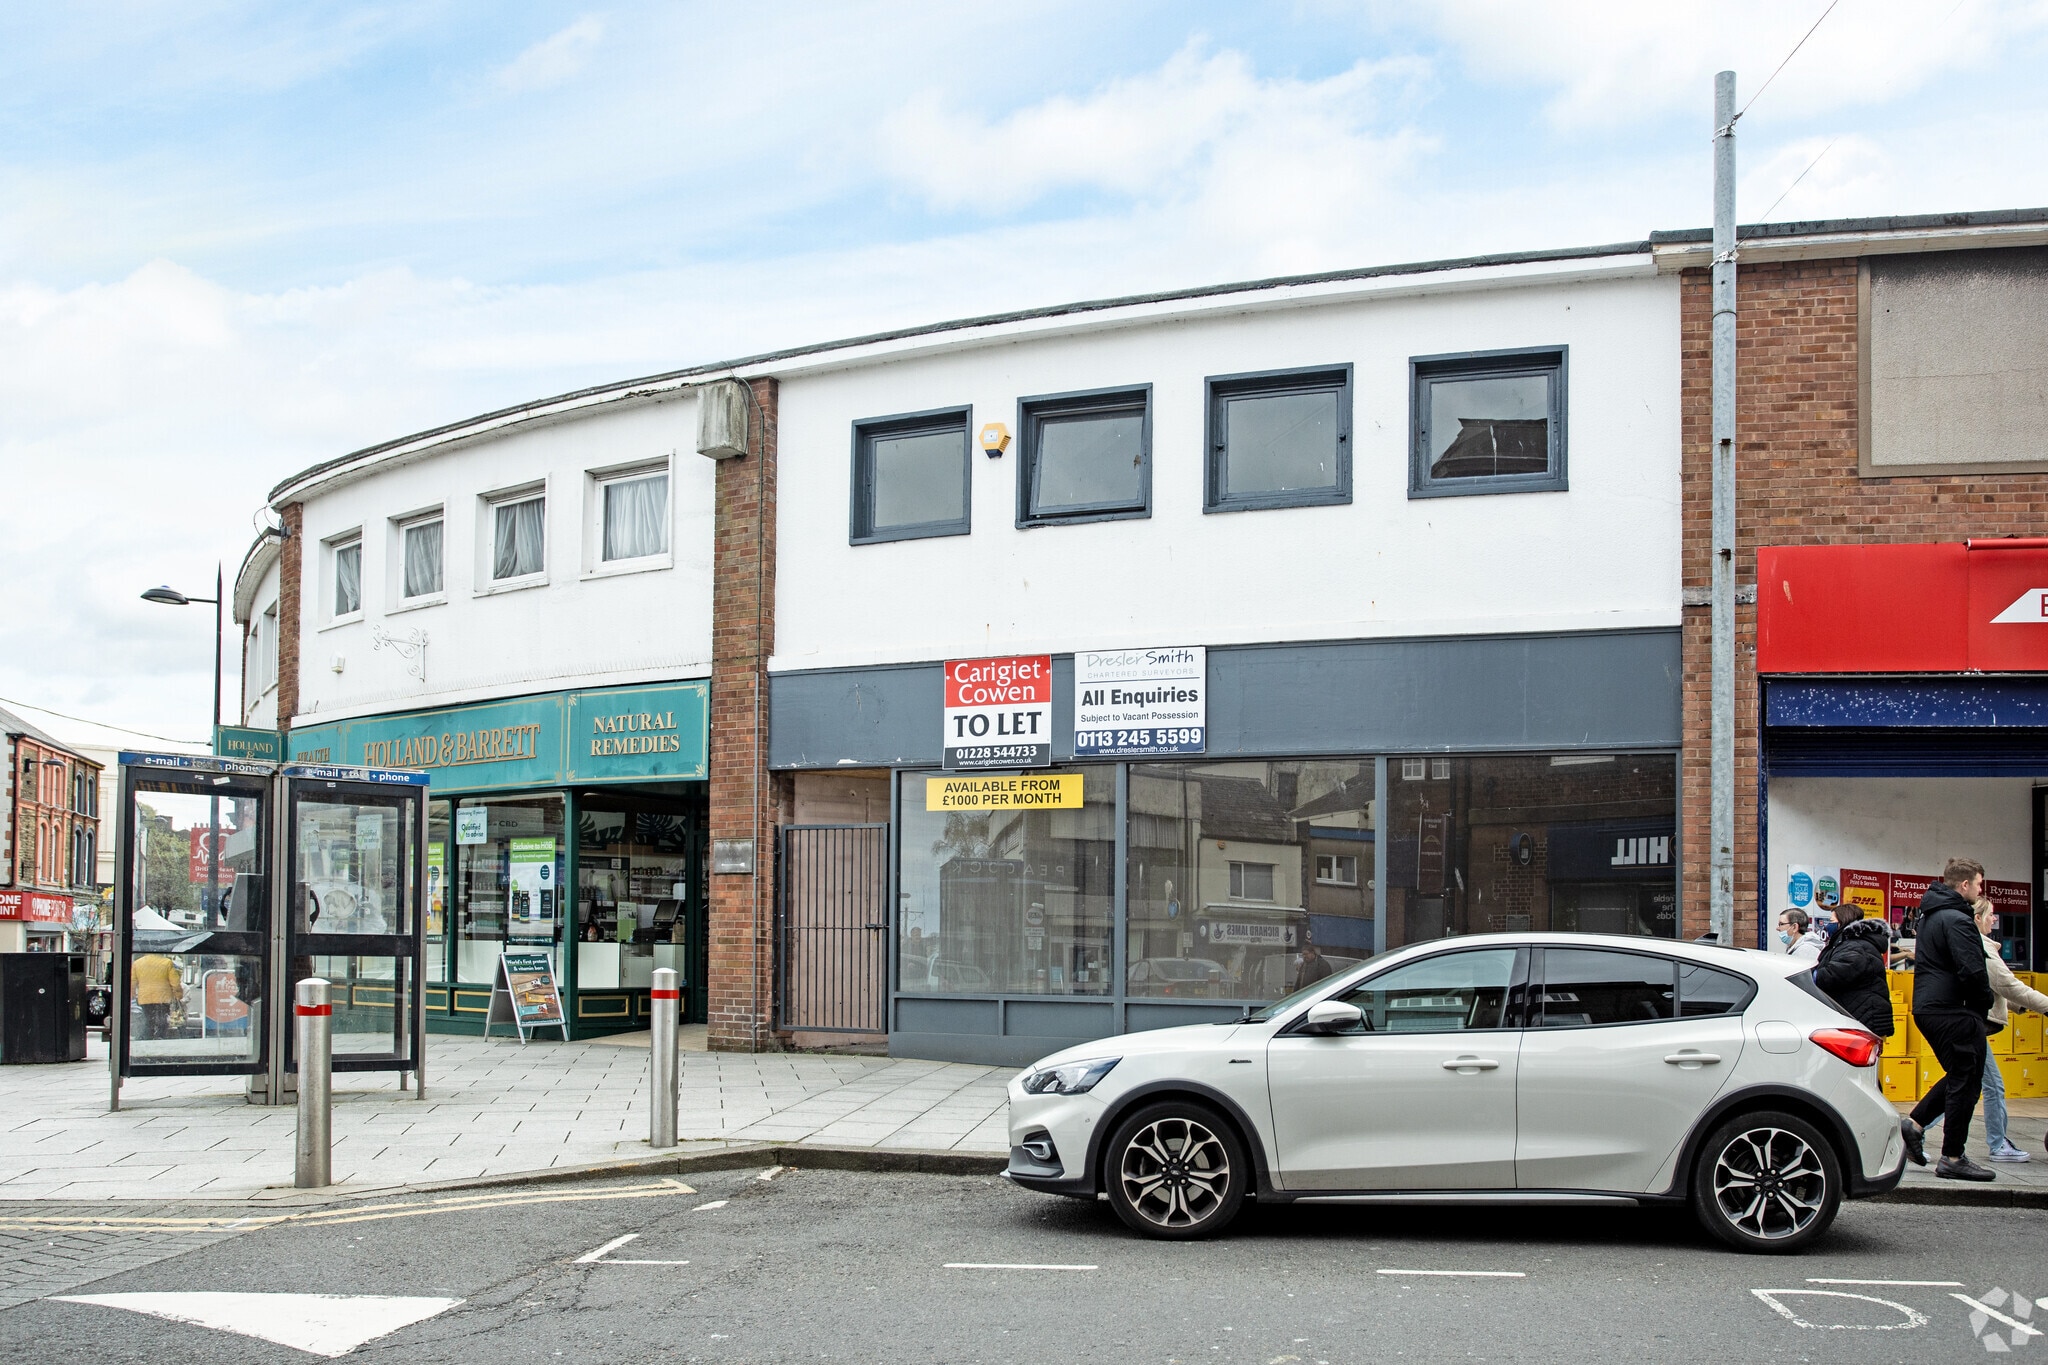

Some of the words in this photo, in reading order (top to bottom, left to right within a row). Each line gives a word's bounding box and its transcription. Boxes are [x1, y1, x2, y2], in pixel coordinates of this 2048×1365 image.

[1086, 652, 1144, 668] Dresler
[1145, 650, 1194, 666] Smith
[954, 660, 1041, 687] Carigiet
[1087, 669, 1138, 678] CHARTERED
[1142, 668, 1194, 677] SURVEYORS
[958, 684, 1036, 704] Cowen
[1082, 689, 1104, 706] All
[1110, 687, 1198, 708] Enquiries
[593, 712, 677, 734] NATURAL
[1080, 712, 1110, 724] Subject
[1112, 713, 1120, 722] to
[1122, 712, 1150, 721] Vacant
[1151, 710, 1198, 720] Possession
[953, 714, 990, 738] TO
[997, 711, 1042, 736] LET
[590, 734, 680, 756] REMEDIES
[1077, 731, 1113, 748] 0113
[1117, 730, 1150, 746] 245
[1156, 728, 1201, 744] 5599
[228, 740, 273, 754] HOLLAND
[364, 736, 438, 768] HOLLAND
[439, 733, 454, 768] &
[454, 724, 541, 760] BARRETT
[956, 747, 992, 760] 01228
[992, 746, 1038, 758] 544733
[1098, 745, 1179, 755] www.dreslersmith.co.uk
[145, 757, 180, 767] e-mail
[958, 757, 1032, 767] www.carigietcowen.co.uk
[306, 768, 338, 778] e-mail
[379, 772, 410, 782] phone
[944, 781, 1018, 793] AVAILABLE
[1021, 780, 1060, 791] FROM
[942, 794, 980, 806] £1000
[982, 794, 1010, 805] PER
[1013, 792, 1062, 804] MONTH
[462, 823, 481, 832] Qualified
[1990, 886, 2027, 896] Ryman
[1852, 896, 1877, 906] DHL
